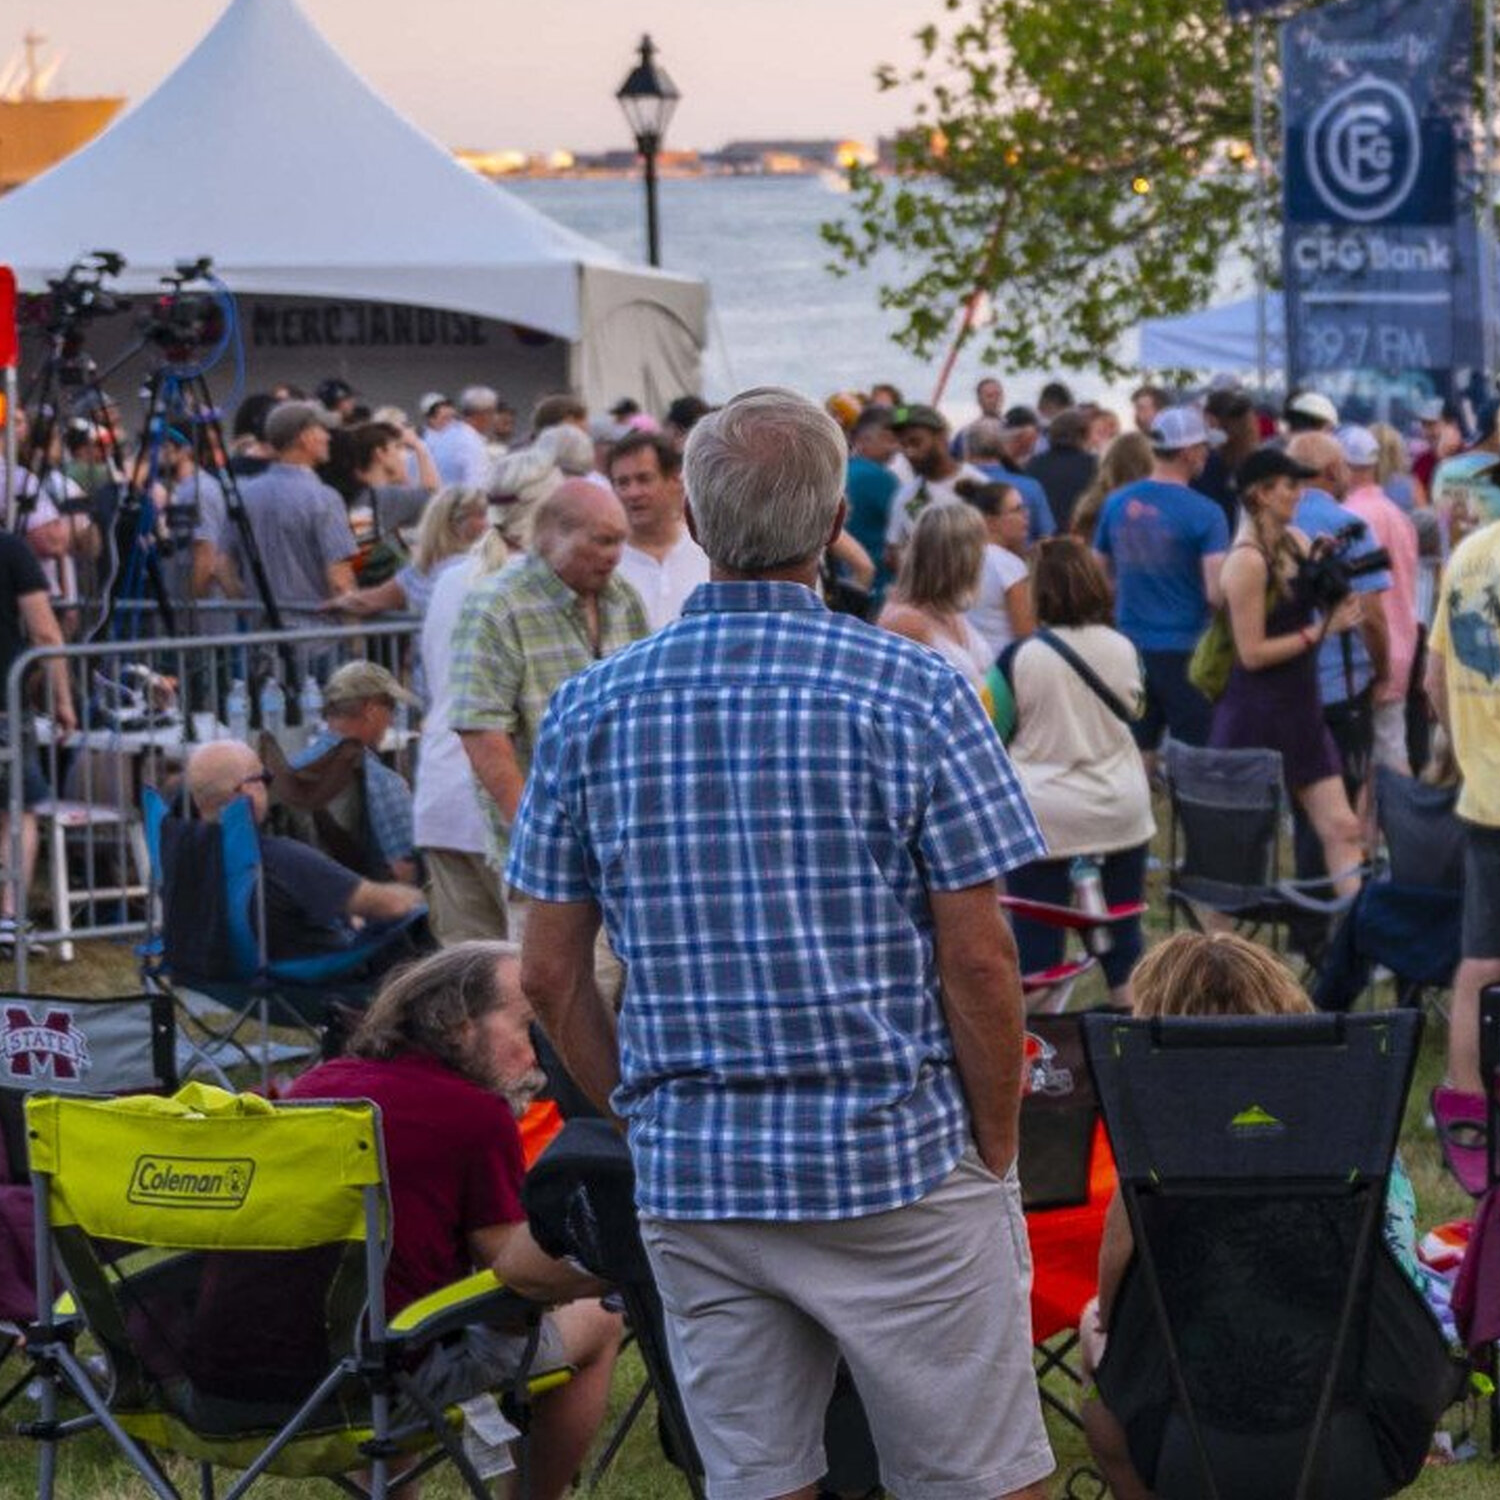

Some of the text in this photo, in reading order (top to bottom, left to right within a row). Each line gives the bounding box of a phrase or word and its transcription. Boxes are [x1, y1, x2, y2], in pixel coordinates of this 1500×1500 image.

[1295, 235, 1451, 272] CFG Bank
[9, 1030, 75, 1055] STATE
[138, 1162, 223, 1193] Coleman
